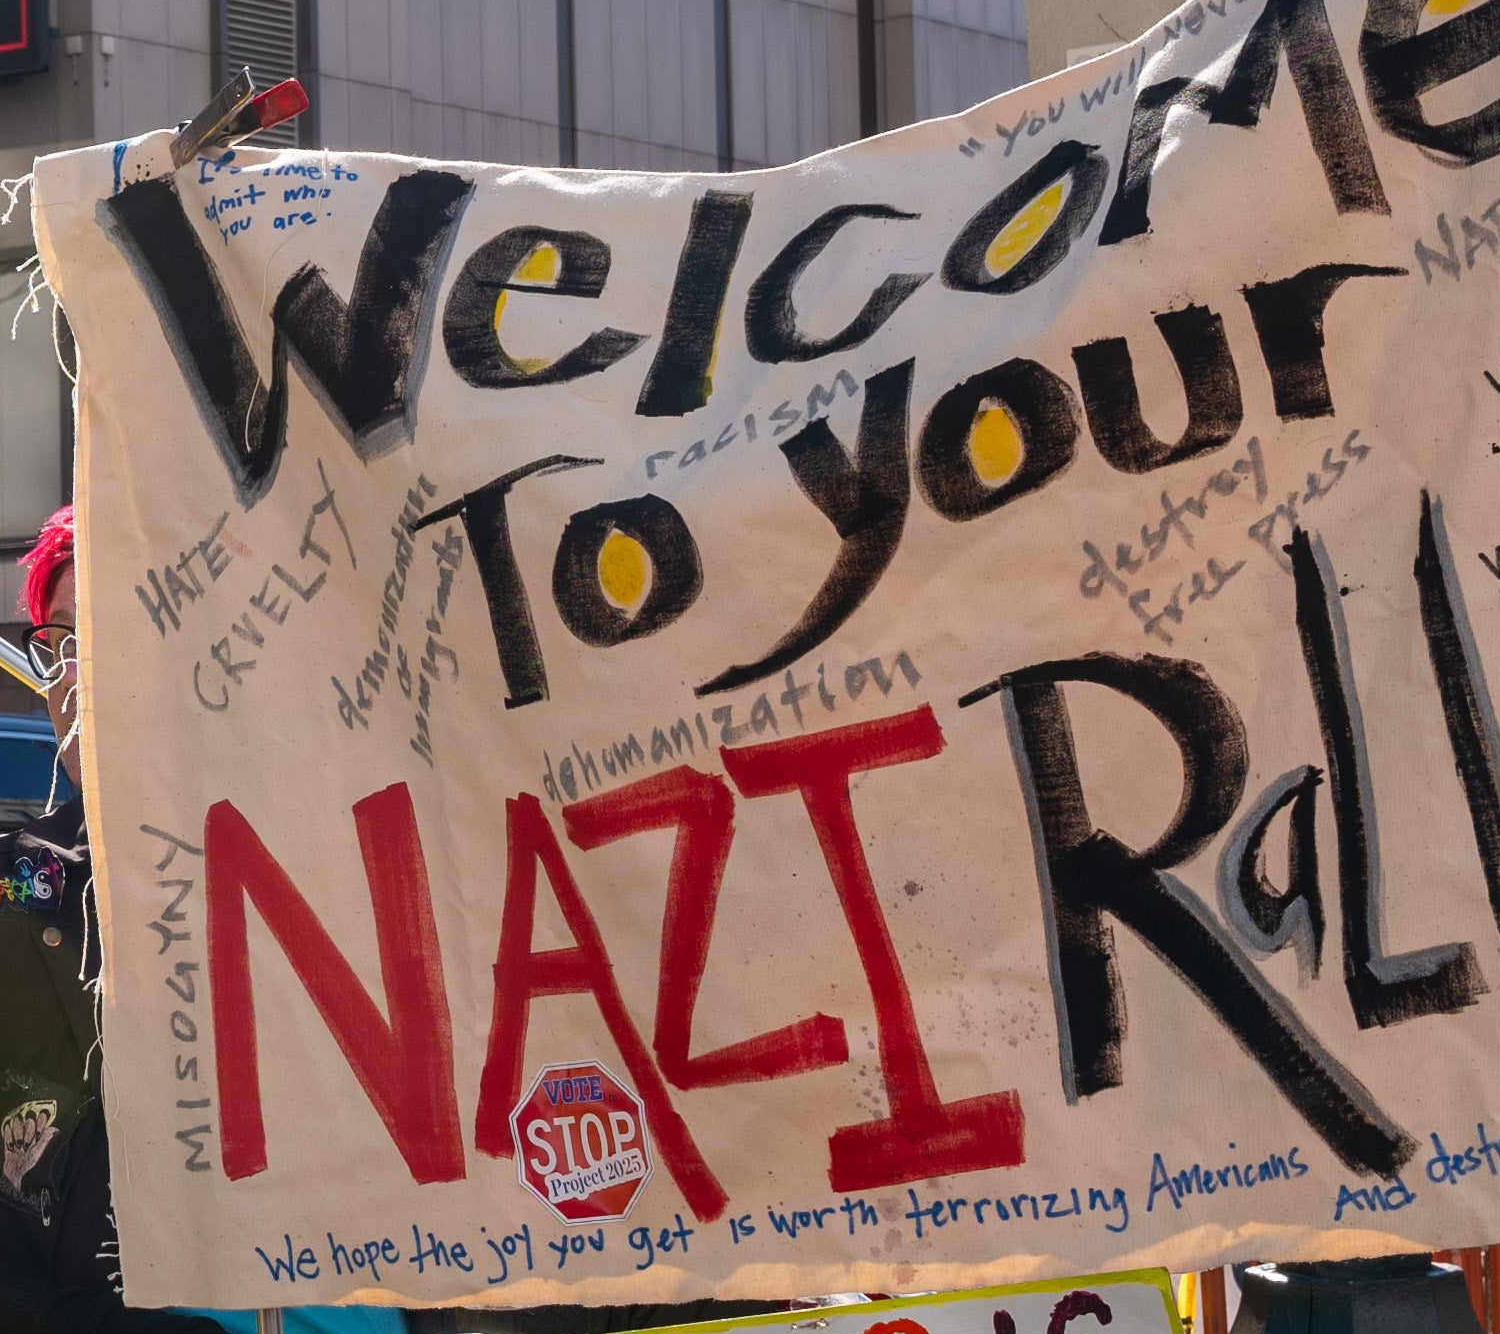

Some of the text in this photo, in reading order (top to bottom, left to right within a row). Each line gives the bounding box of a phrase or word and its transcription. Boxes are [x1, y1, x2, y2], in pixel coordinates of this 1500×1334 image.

[219, 215, 253, 246] you
[414, 261, 1410, 710] To your
[1079, 435, 1268, 599] destroy
[134, 511, 234, 639] HATE
[202, 700, 1028, 1224] NAZI
[526, 1110, 636, 1176] STOP
[541, 1075, 604, 1105] VOTE
[255, 1234, 322, 1284] We
[331, 1225, 400, 1281] hope
[407, 1221, 474, 1275] the
[486, 1223, 532, 1284] joy
[549, 1227, 606, 1268] you
[628, 1215, 695, 1271] get
[768, 1192, 878, 1238] worth
[1146, 1143, 1310, 1215] Americans
[550, 1154, 642, 1198] Project 2025
